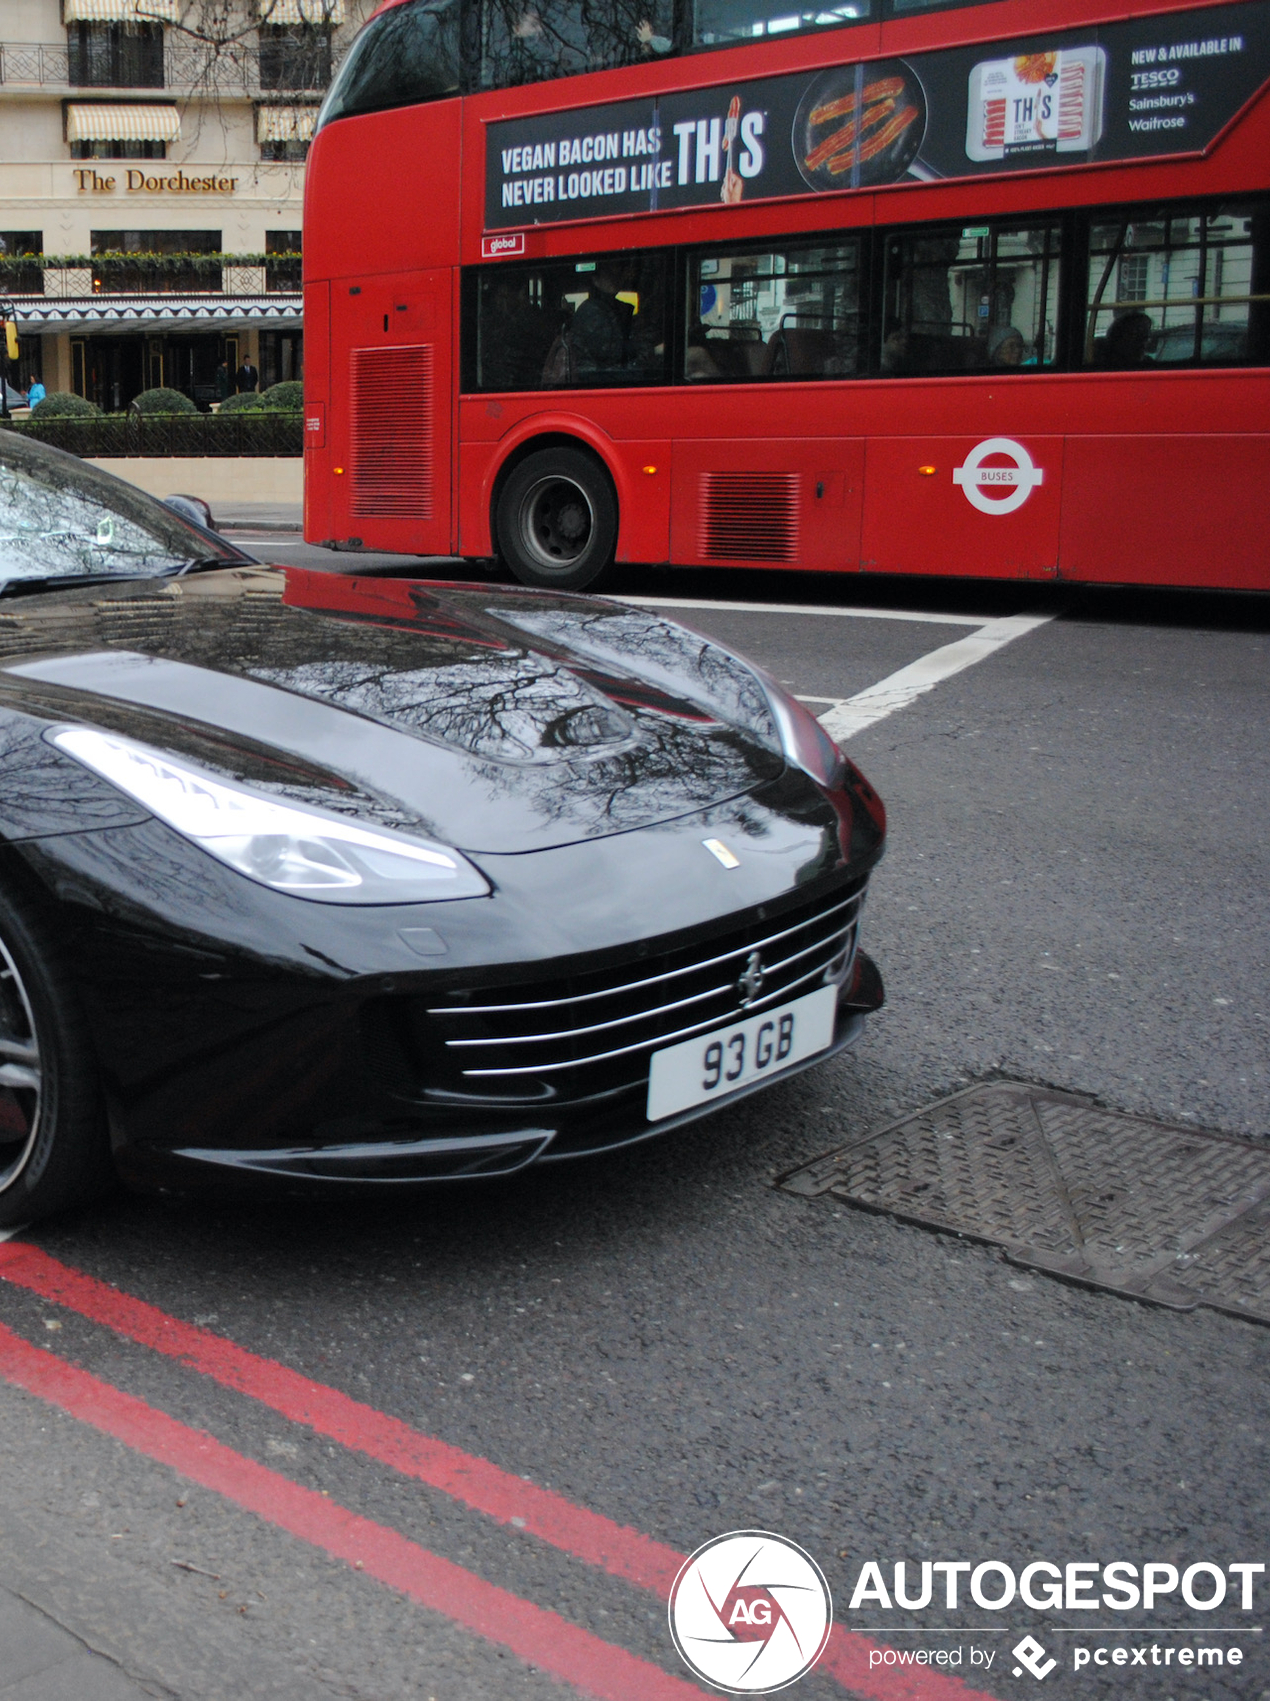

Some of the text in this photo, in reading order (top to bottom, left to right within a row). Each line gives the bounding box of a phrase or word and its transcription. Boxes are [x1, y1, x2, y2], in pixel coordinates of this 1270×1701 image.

[1131, 36, 1242, 65] NEW & AVAILABLE IN
[1131, 69, 1179, 85] TESCO
[1129, 92, 1194, 111] Sainsbury's
[1128, 116, 1186, 131] Waitrose
[501, 127, 662, 175] VEGAN BACON HAS
[73, 169, 239, 192] The Dorchester
[501, 161, 672, 208] NEVER LOOKED LIKE
[490, 236, 516, 253] global
[981, 472, 1013, 481] BUSES
[702, 1012, 794, 1090] 93 GB
